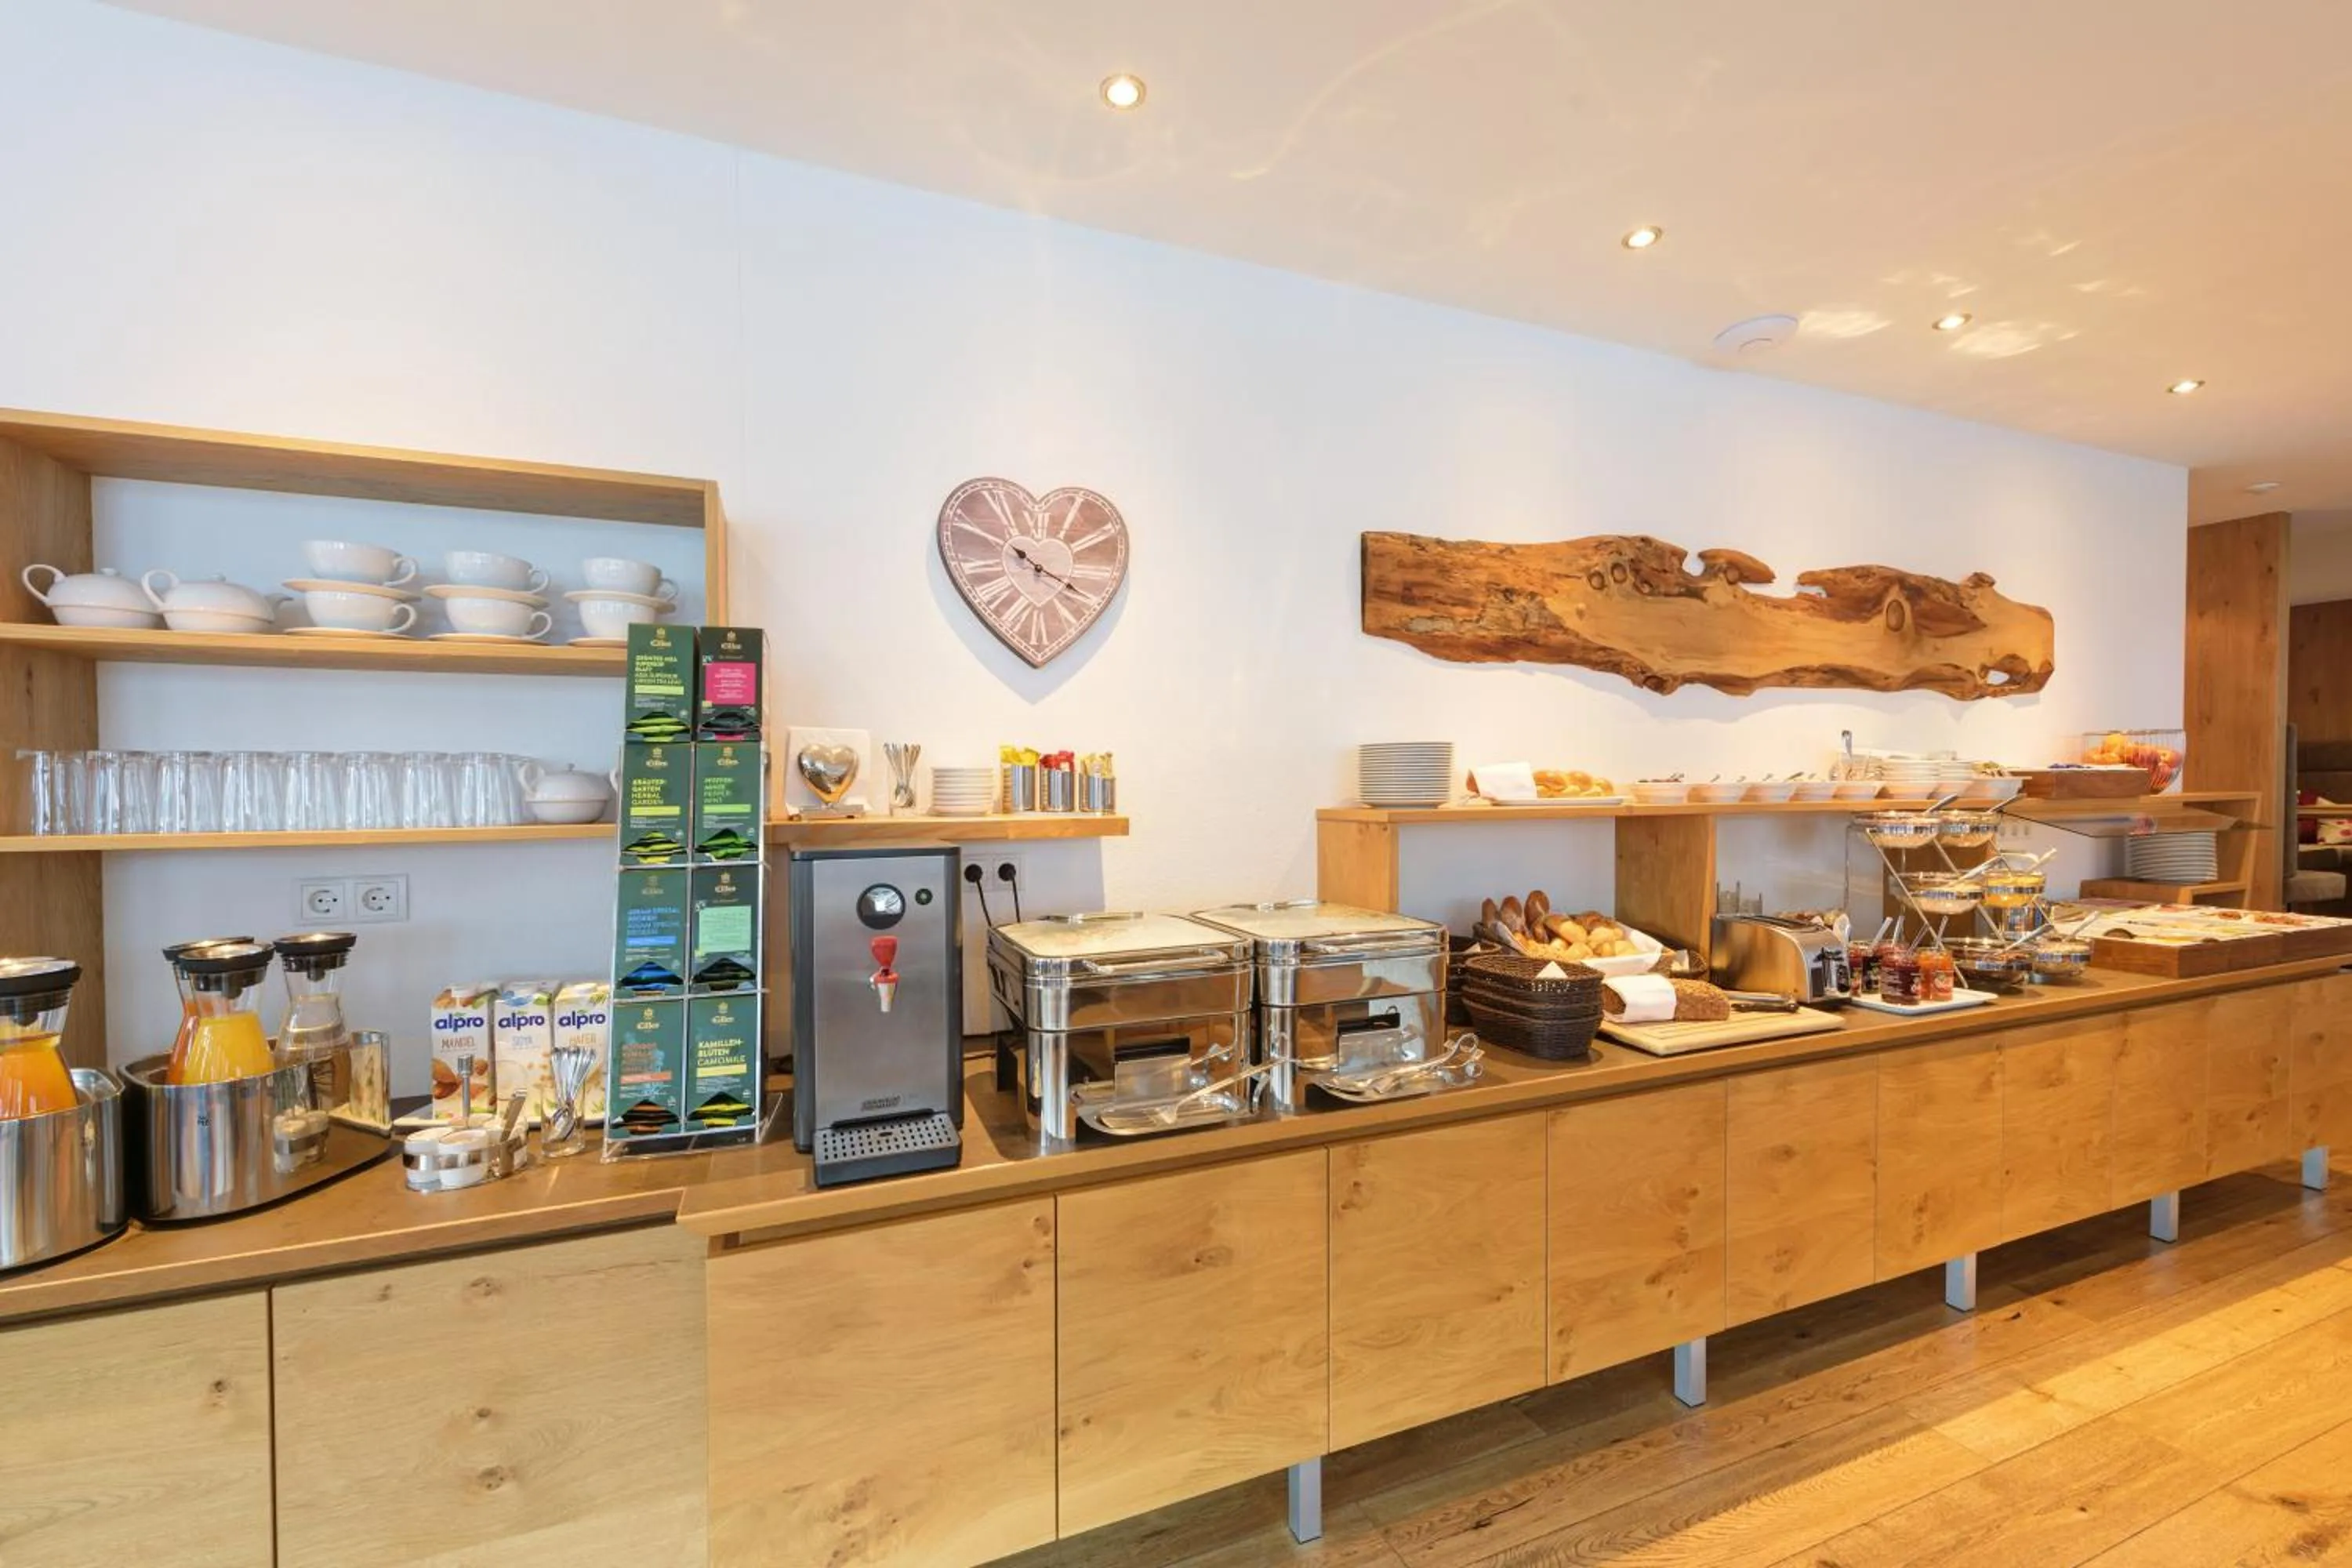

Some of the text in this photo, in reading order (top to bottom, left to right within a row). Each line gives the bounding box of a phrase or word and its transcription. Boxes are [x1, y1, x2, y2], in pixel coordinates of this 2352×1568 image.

[435, 1013, 484, 1033] alpro
[499, 1012, 544, 1031] alpro
[558, 1011, 606, 1029] alpro
